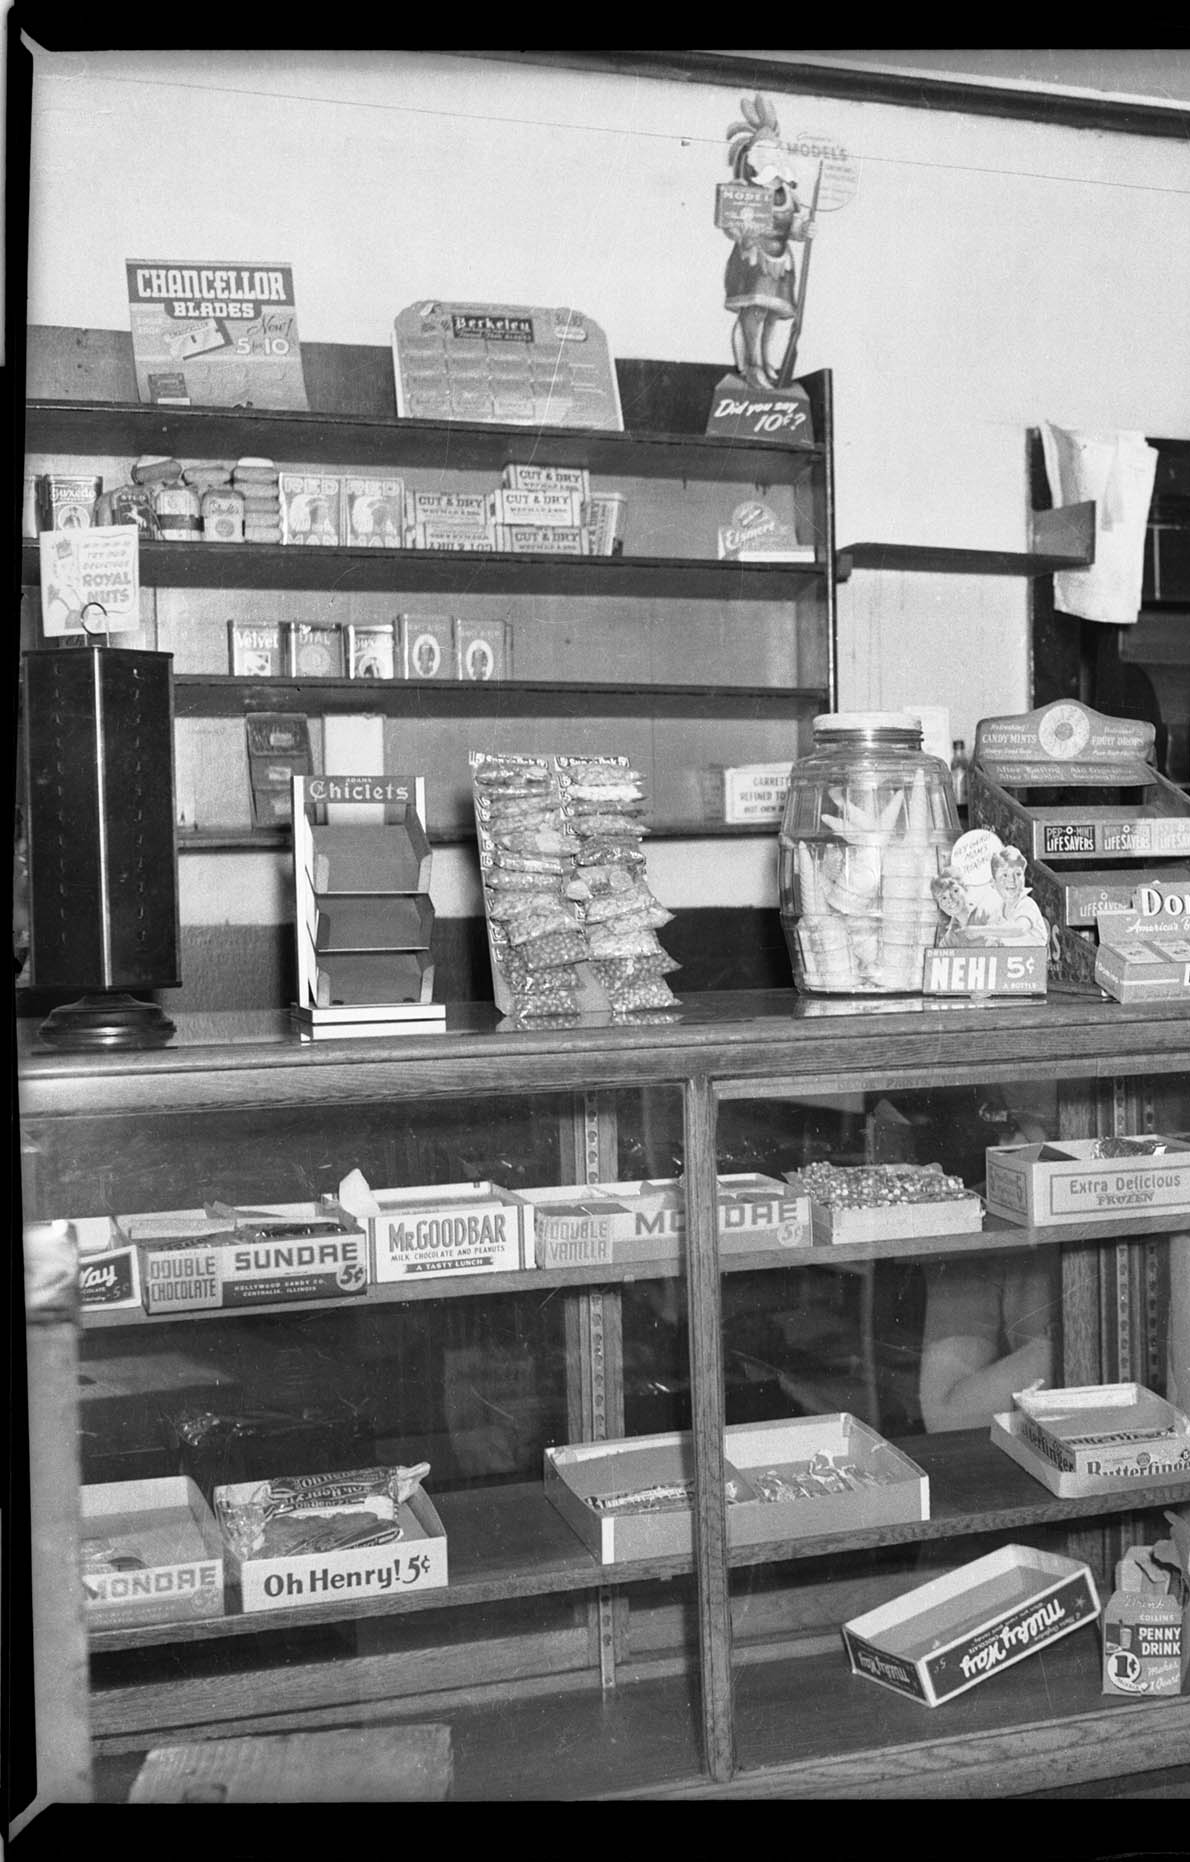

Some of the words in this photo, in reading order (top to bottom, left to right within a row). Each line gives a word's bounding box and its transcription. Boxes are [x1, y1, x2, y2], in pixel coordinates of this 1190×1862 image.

[136, 269, 287, 301] CHANCELLOR
[172, 301, 255, 318] BLADES
[455, 316, 532, 333] Berkeley
[236, 337, 250, 355] 5
[714, 398, 749, 418] Did
[746, 400, 773, 416] you
[773, 401, 799, 414] say
[519, 469, 543, 482] CUT
[555, 471, 581, 484] DRY
[283, 479, 340, 495] RED
[349, 480, 400, 496] RED
[418, 495, 443, 507] CUT
[457, 497, 484, 510] DRY
[505, 493, 529, 506] CUT
[545, 493, 569, 506] DRY
[514, 531, 538, 544] CUT
[554, 531, 580, 544] DRY
[82, 572, 132, 588] ROYAL
[86, 589, 130, 604] NUTS
[234, 630, 280, 649] Velvet
[982, 733, 1009, 745] CANDY
[1009, 733, 1038, 745] MINTS
[309, 780, 409, 801] Chiclets
[1046, 825, 1094, 838] PEP-O-MINT
[930, 956, 998, 991] NEHI
[1006, 956, 1036, 979] 5¢
[1069, 1178, 1109, 1194] Extra
[1115, 1173, 1182, 1191] Delicious
[1096, 1192, 1155, 1206] FROZEN
[415, 1213, 507, 1251] GOODBAR
[549, 1220, 608, 1241] DOUBLE
[235, 1241, 358, 1272] SUNDAE
[391, 1253, 410, 1262] MILK
[414, 1250, 454, 1260] CHOCOLATE
[456, 1248, 472, 1257] AND
[473, 1245, 505, 1255] PEANUTS
[551, 1240, 608, 1260] VANILLA
[150, 1255, 216, 1280] DOUBLE
[425, 1261, 453, 1270] TASTY
[455, 1258, 483, 1267] LUNCH
[339, 1263, 365, 1286] 5¢
[151, 1279, 217, 1302] CHOCOLATE
[234, 1281, 281, 1291] HOLLYWOOD
[284, 1279, 315, 1288] CANDY
[263, 1571, 303, 1597] Oh
[309, 1559, 402, 1592] Henry!
[402, 1555, 432, 1585] 5¢
[1001, 1599, 1065, 1651] Milky
[1138, 1627, 1181, 1641] PENNY
[1141, 1642, 1181, 1656] DRINK
[959, 1645, 1007, 1679] Way
[1114, 1655, 1138, 1679] 1¢
